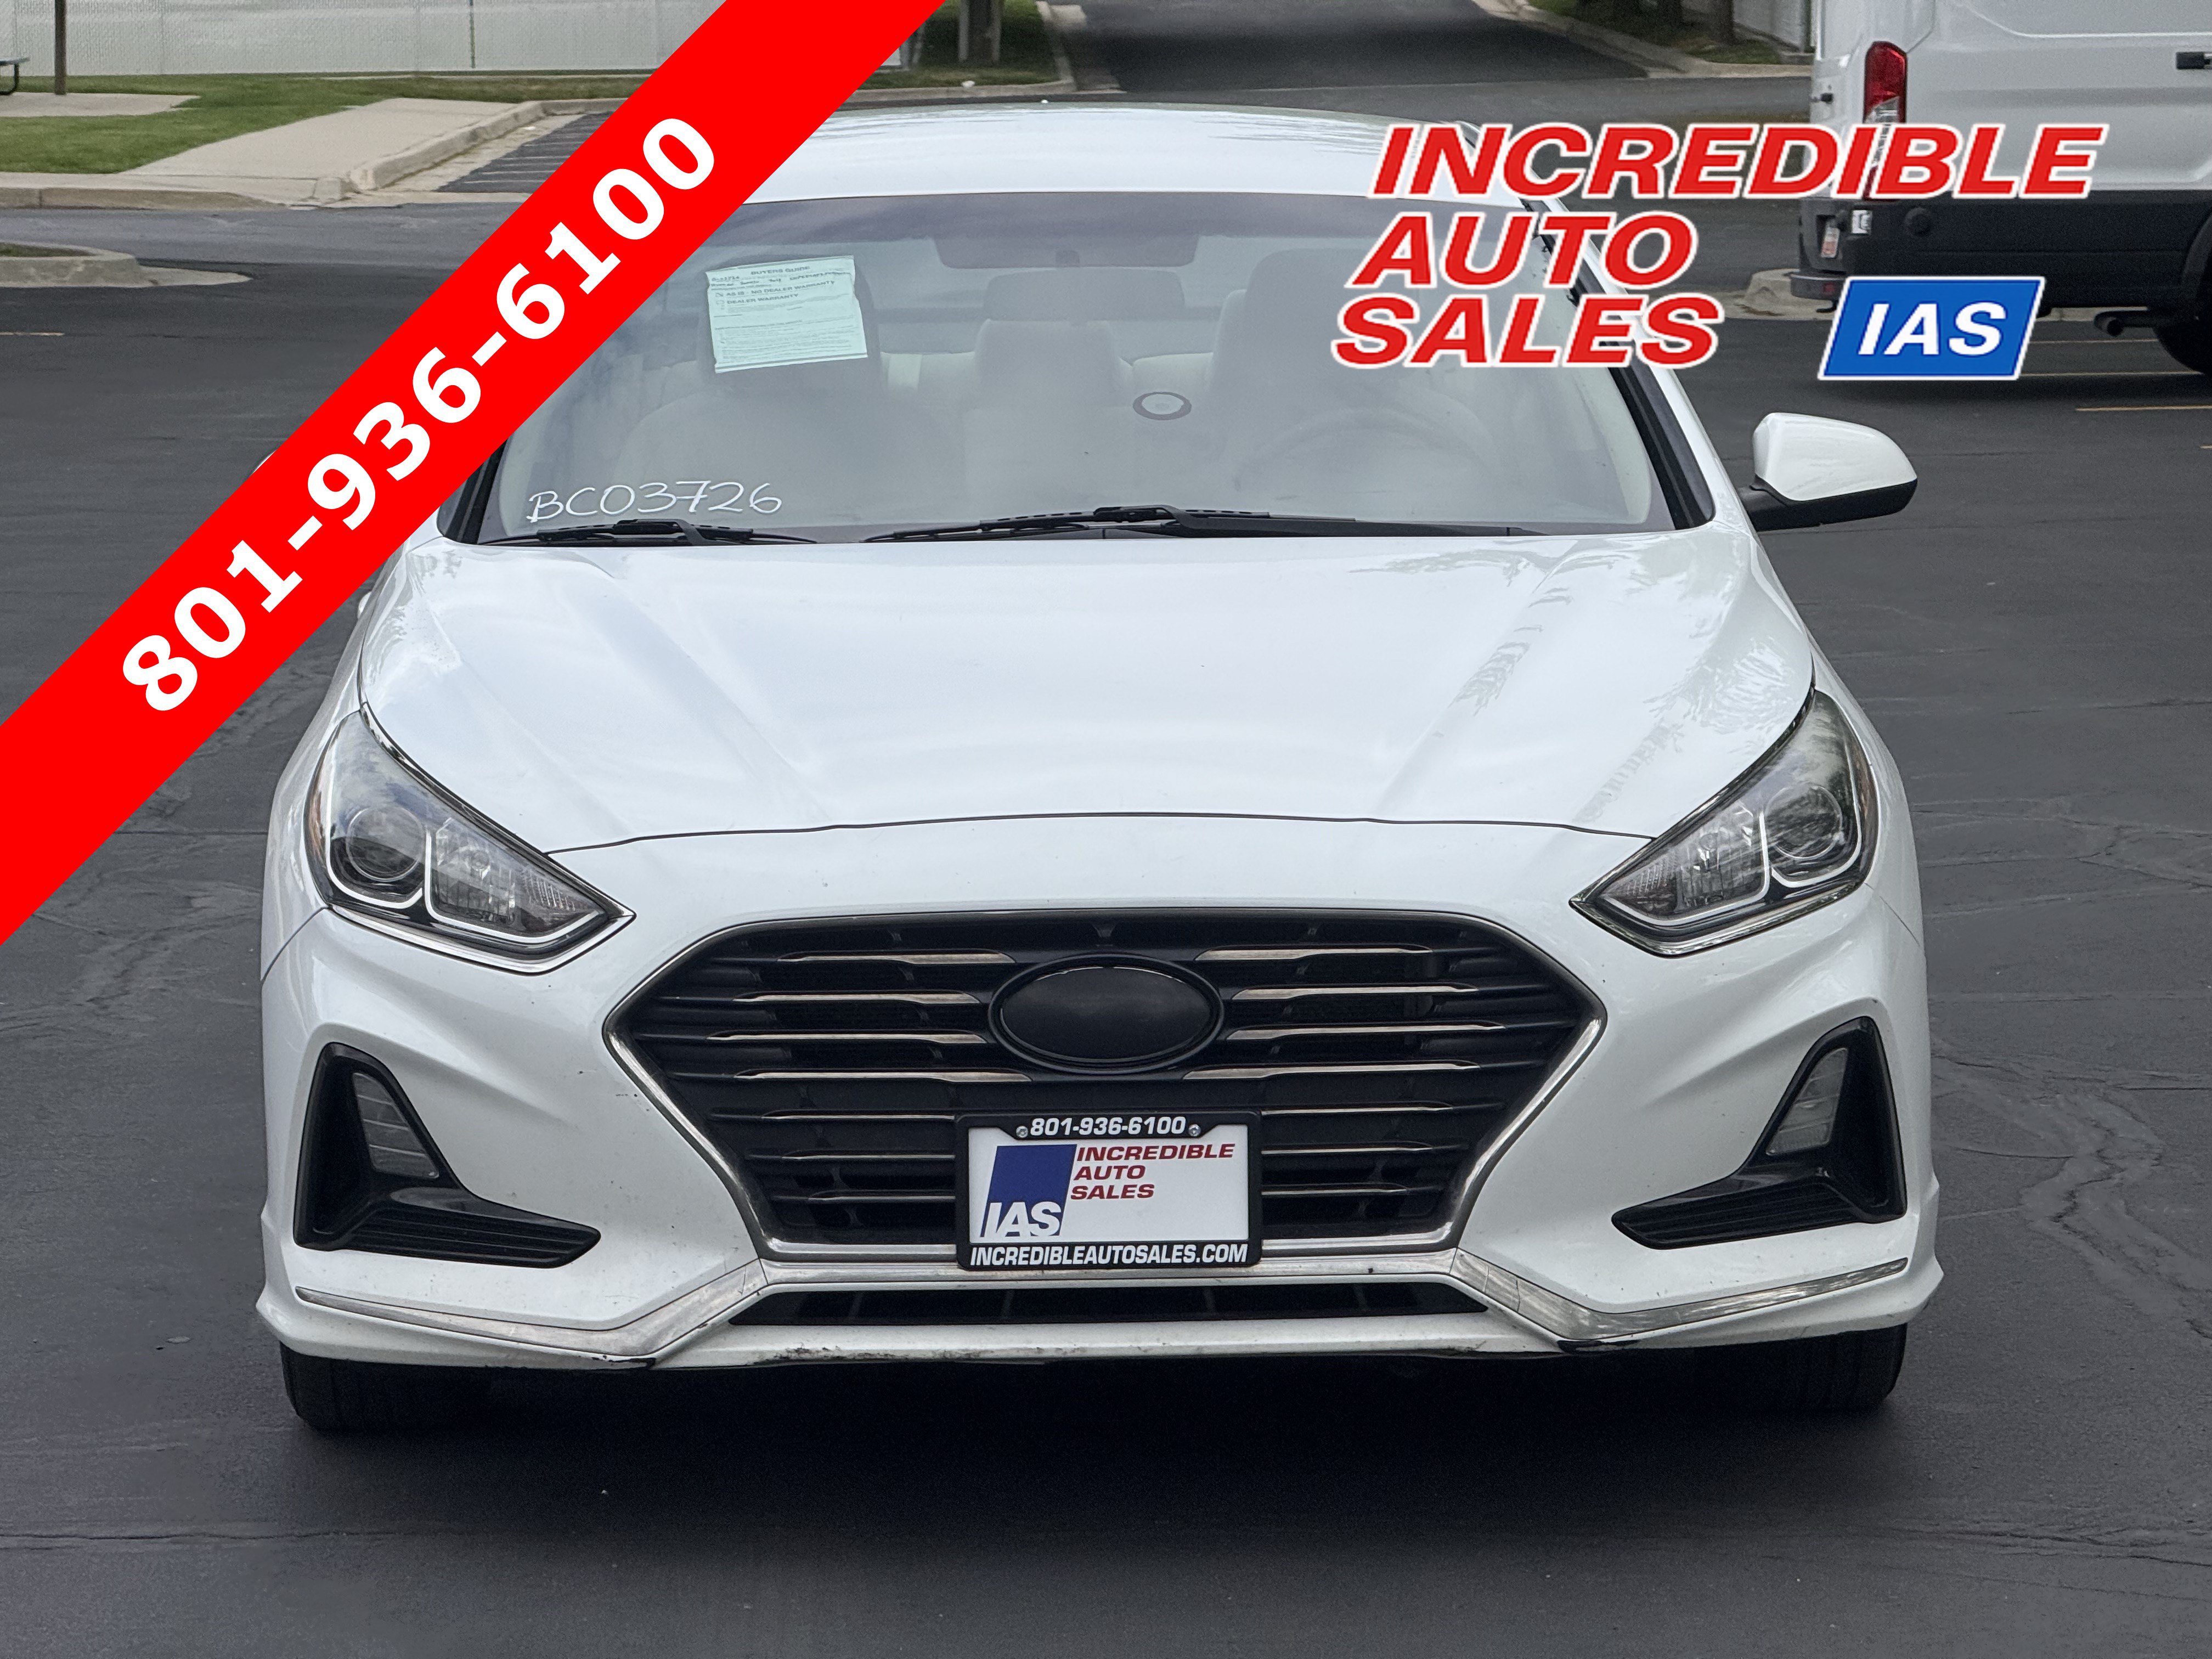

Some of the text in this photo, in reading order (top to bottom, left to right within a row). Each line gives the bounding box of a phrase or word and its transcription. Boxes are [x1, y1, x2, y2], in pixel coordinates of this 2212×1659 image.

[1030, 1116, 1186, 1136] 801-936-6100
[1076, 1143, 1236, 1162] INCREDIBLE
[1073, 1164, 1146, 1181] AUTO
[1070, 1183, 1155, 1200] SALES
[983, 1200, 1063, 1238] IAS
[969, 1243, 1248, 1266] INCREDIBLEAUTOSALES.COM
